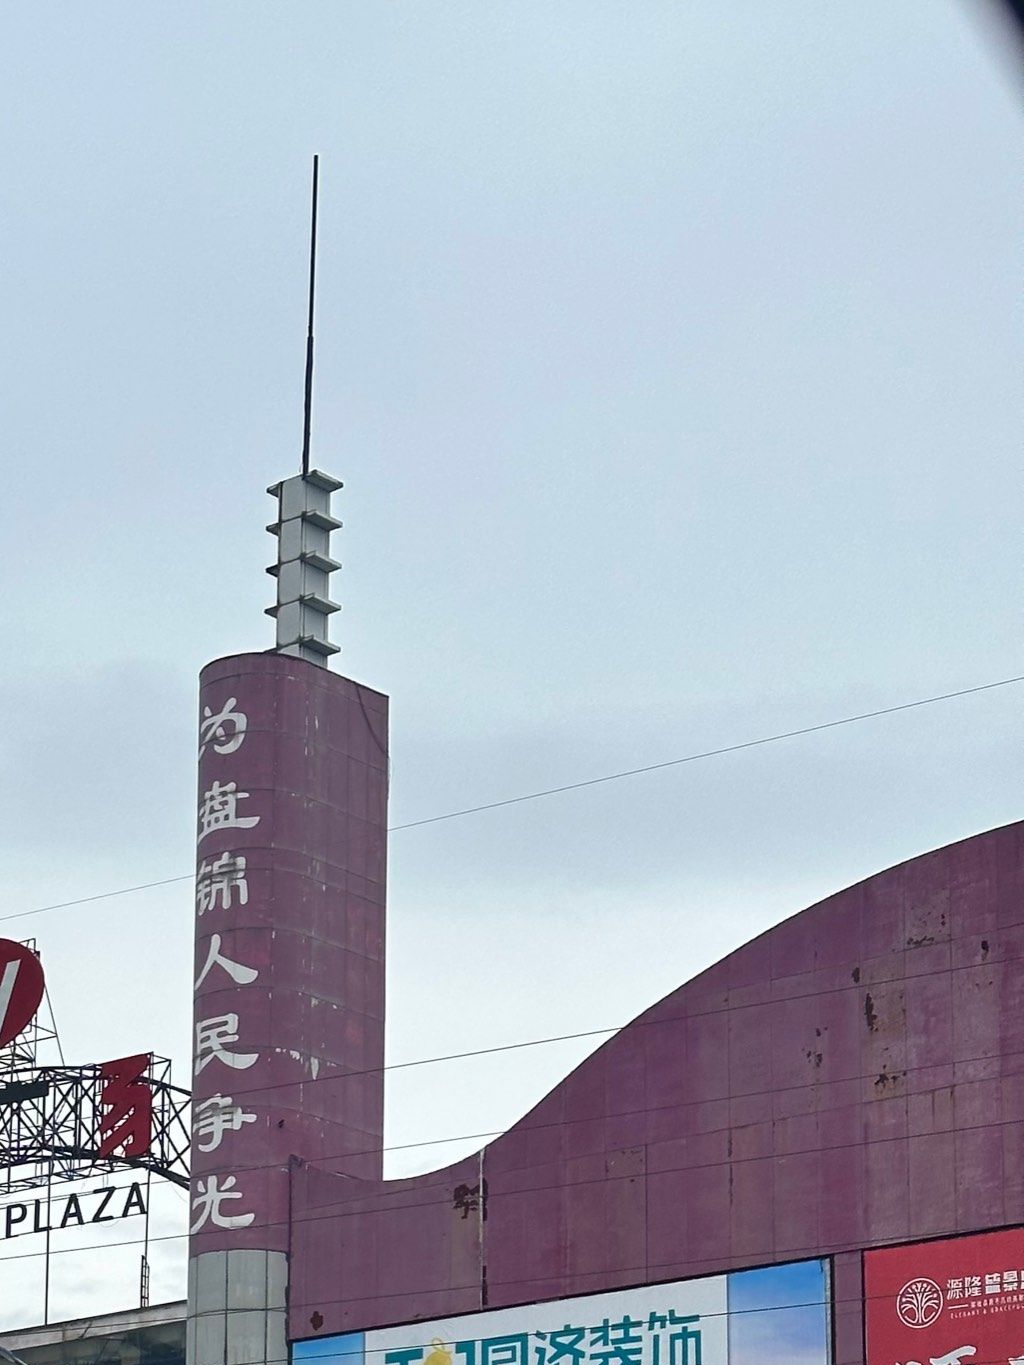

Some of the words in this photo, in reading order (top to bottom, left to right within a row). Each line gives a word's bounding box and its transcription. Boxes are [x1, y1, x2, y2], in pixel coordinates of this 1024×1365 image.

[190, 697, 260, 1236] 为盘锦人民争光
[6, 1182, 148, 1239] PLAZA
